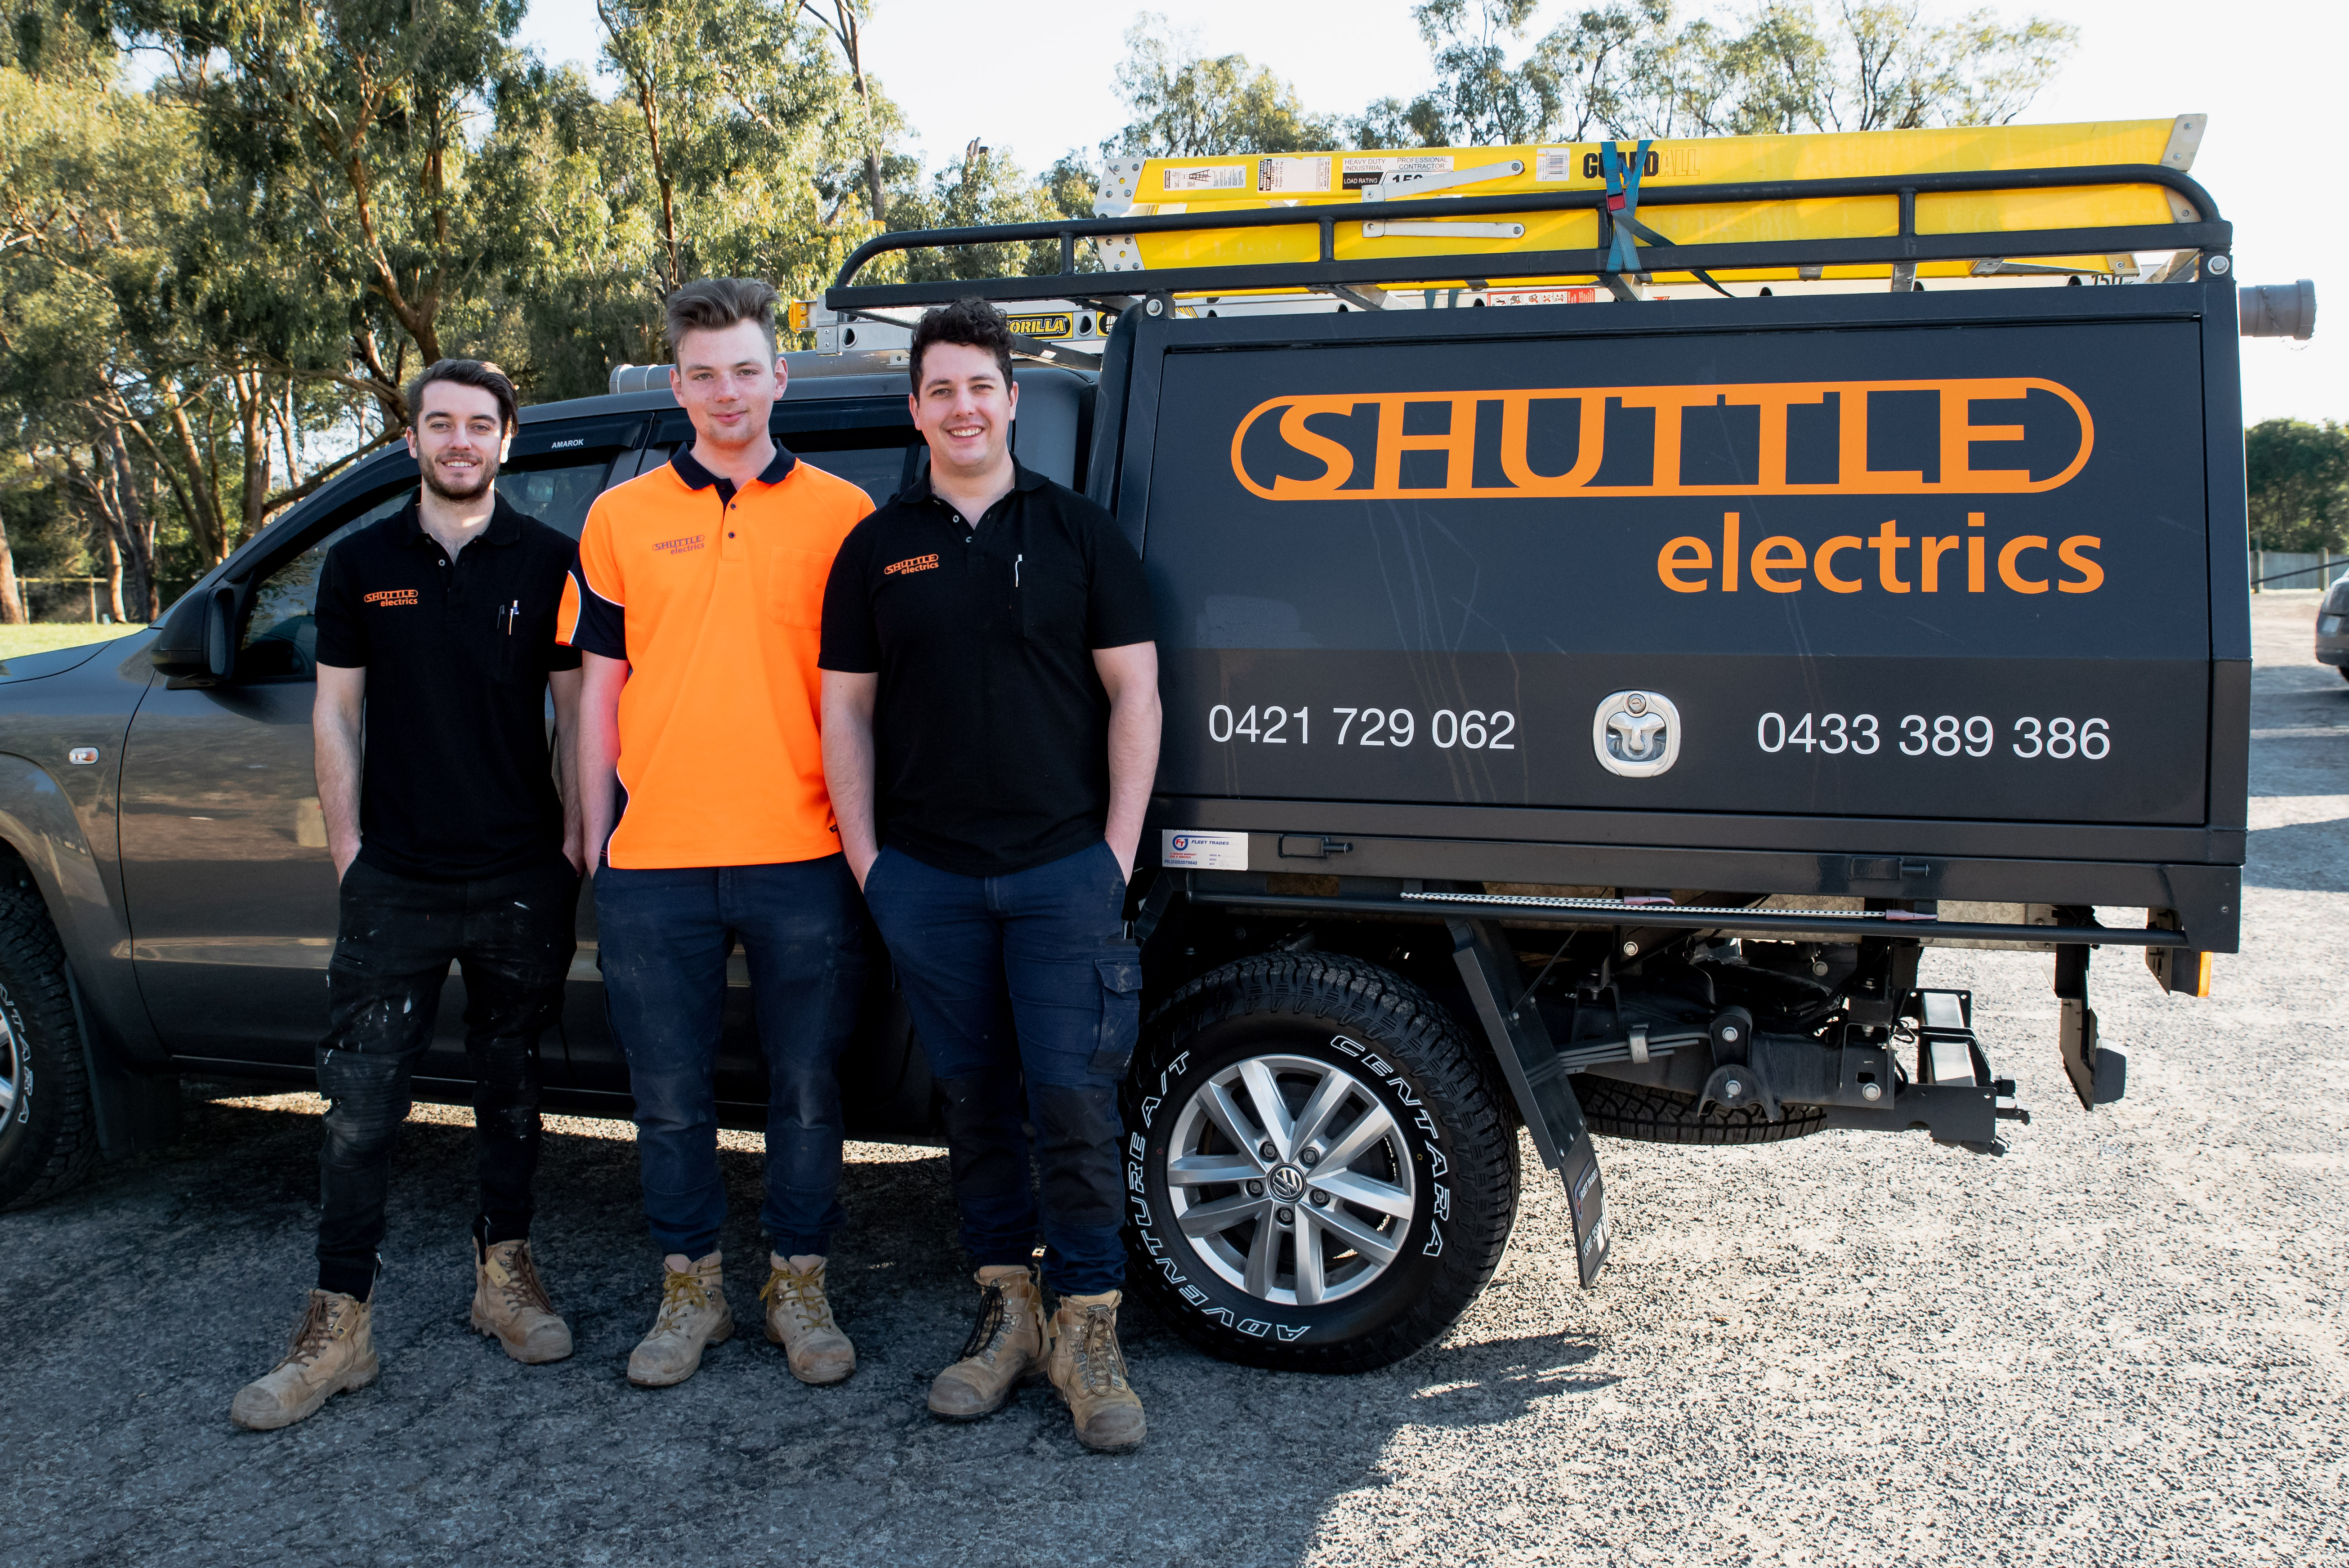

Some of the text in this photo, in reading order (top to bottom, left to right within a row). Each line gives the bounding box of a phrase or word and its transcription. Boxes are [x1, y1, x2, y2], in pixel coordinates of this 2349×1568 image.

[1583, 149, 1700, 179] GDALL
[1007, 318, 1066, 334] ORILLA
[551, 438, 584, 449] AMAROK
[1271, 377, 2032, 501] SHUTTLE
[654, 535, 703, 551] SHUTTLE
[670, 543, 705, 554] electrics
[1657, 512, 2104, 594] electrics
[885, 554, 937, 575] SHUTTLE
[901, 562, 939, 574] electrics
[365, 590, 416, 603] SHUTTLE
[380, 598, 418, 607] electrics
[1209, 704, 1515, 749] 0421 729 062
[1757, 712, 2110, 759] 0433 389 386
[1330, 1035, 1450, 1258] CENTARA
[1580, 1167, 1598, 1201] FLEET TRADES
[1128, 1131, 1311, 1342] ADVENTURE
